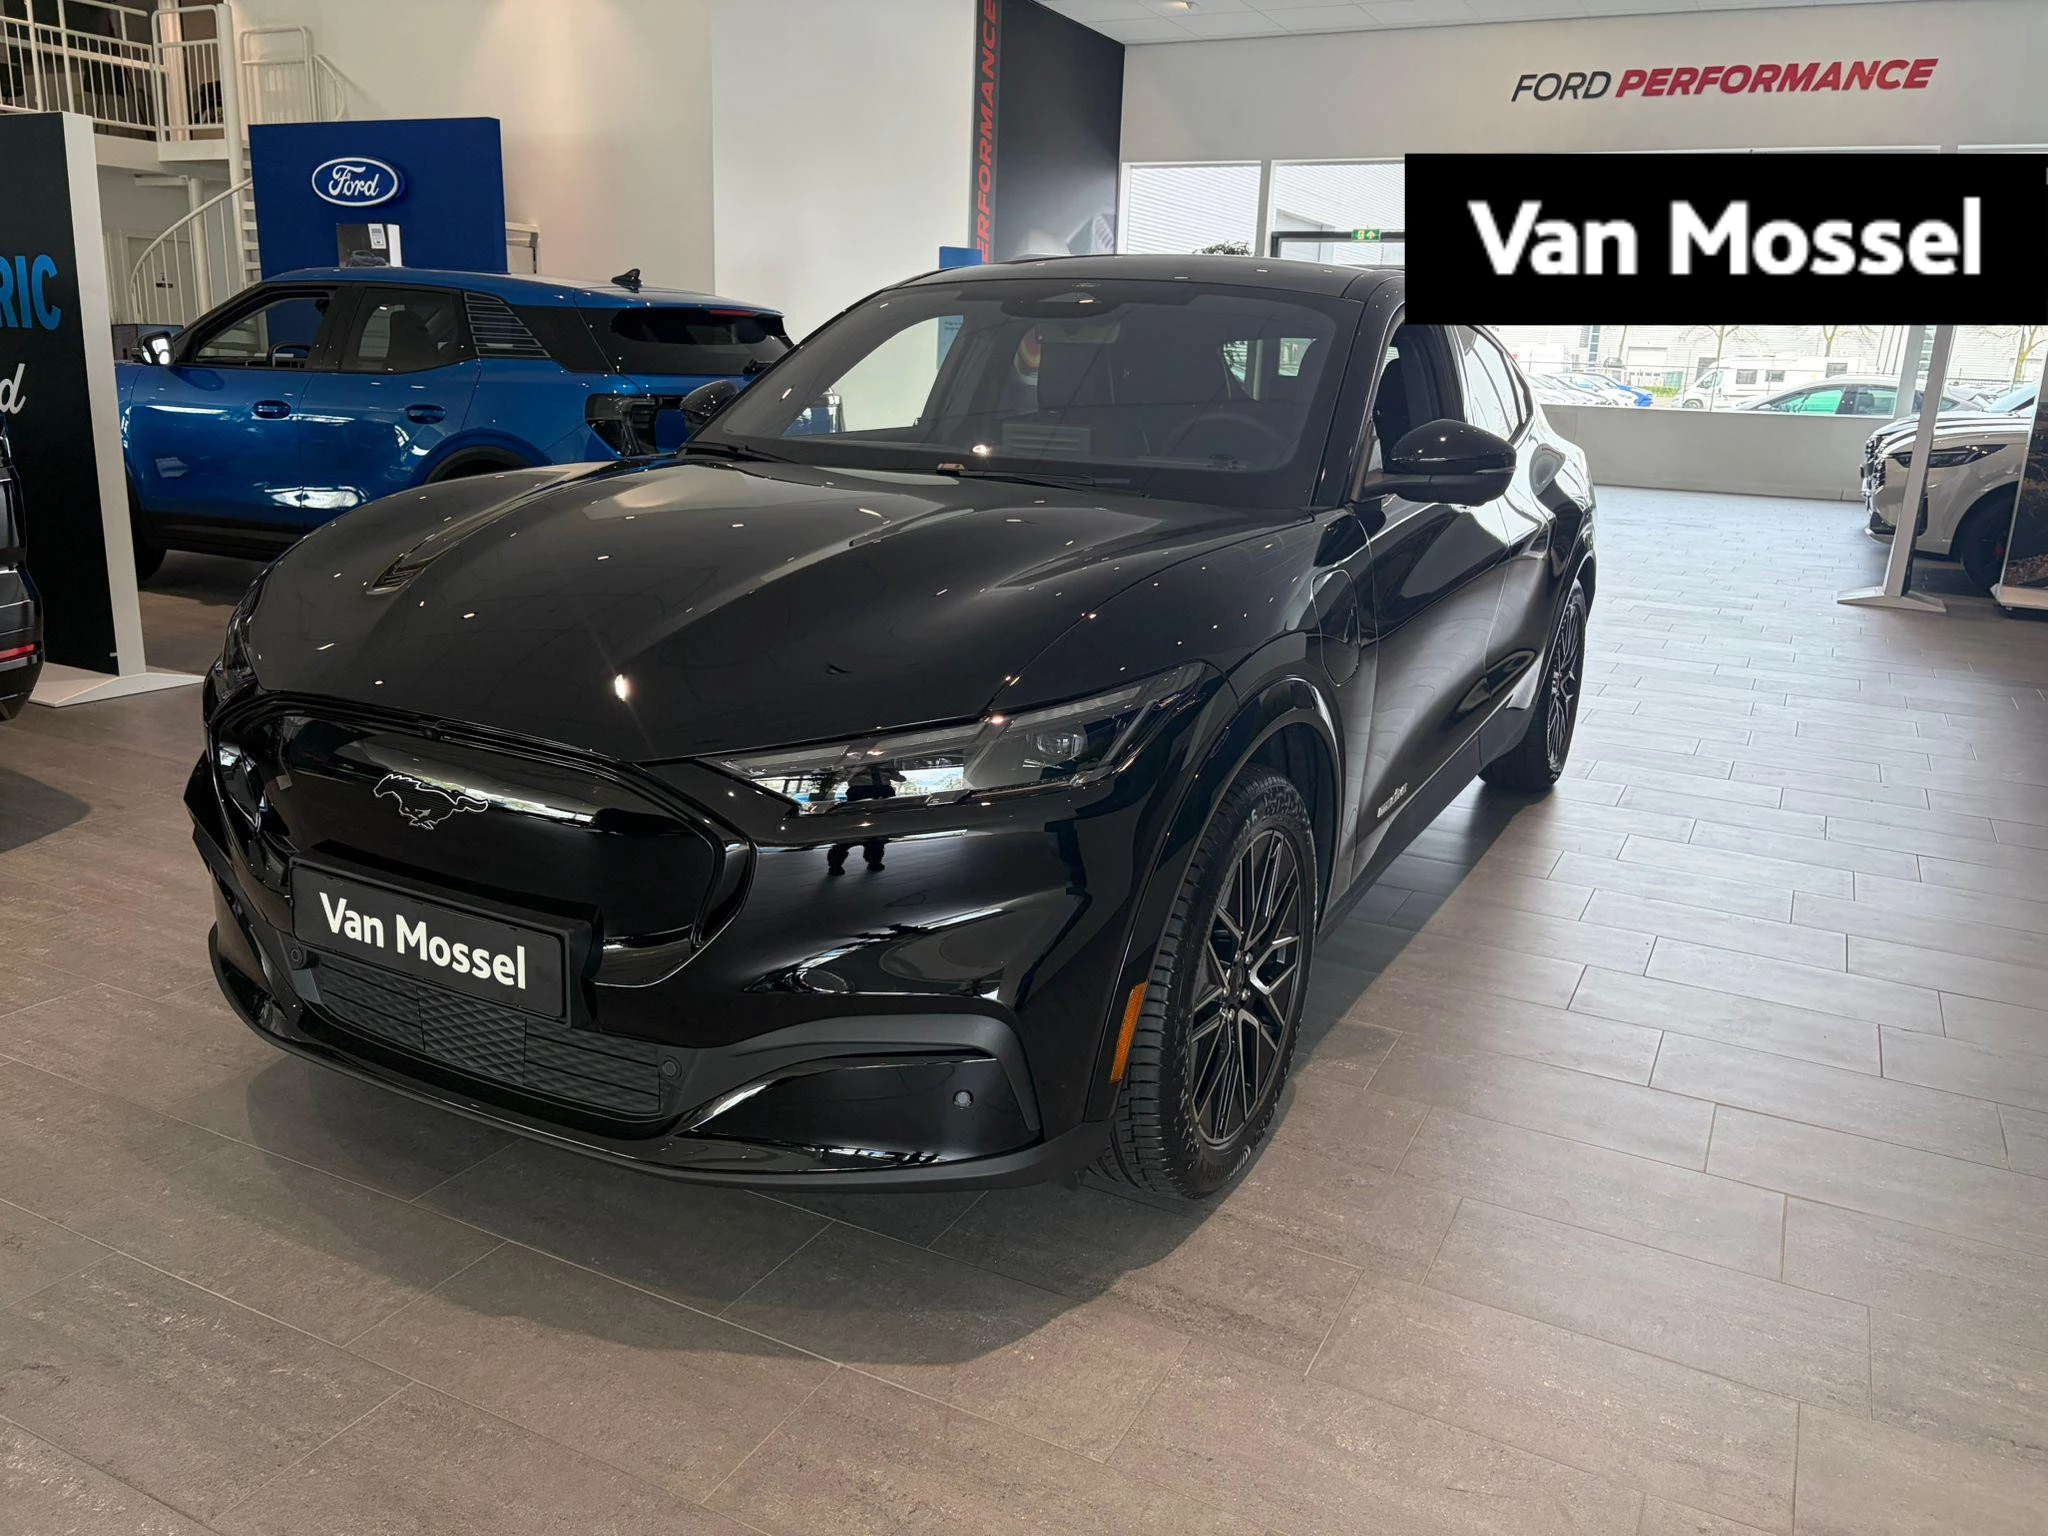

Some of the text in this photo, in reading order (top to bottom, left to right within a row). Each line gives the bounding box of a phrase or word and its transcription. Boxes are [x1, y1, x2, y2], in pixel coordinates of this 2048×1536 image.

[1511, 58, 1939, 102] FORD PERFORMANCE
[977, 0, 998, 265] ERFORMANCE
[328, 165, 380, 197] Ford
[319, 891, 526, 990] Van Mossel
